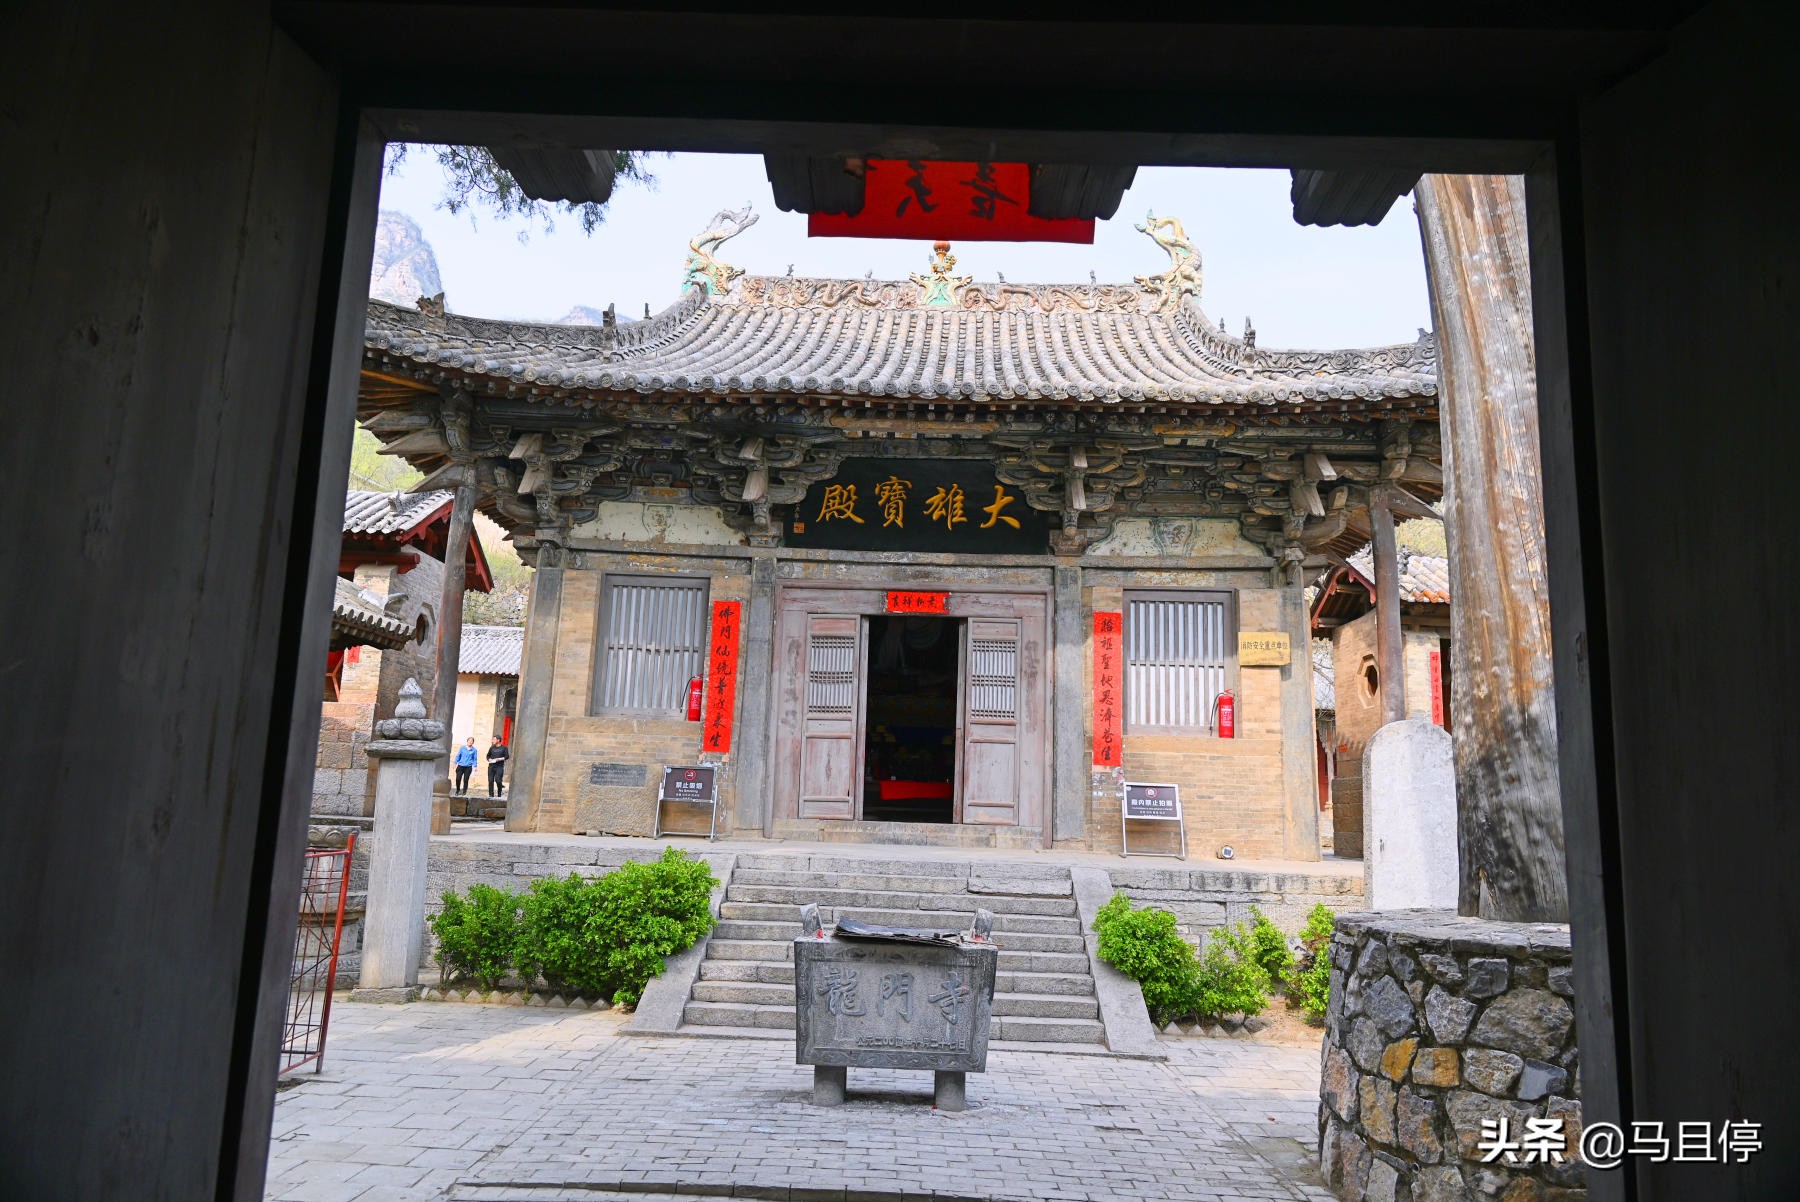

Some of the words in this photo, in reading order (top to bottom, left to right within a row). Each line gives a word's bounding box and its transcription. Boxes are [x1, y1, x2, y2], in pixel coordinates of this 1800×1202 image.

[816, 476, 1021, 531] 大雄寶殿
[818, 967, 969, 1026] 龍門寺
